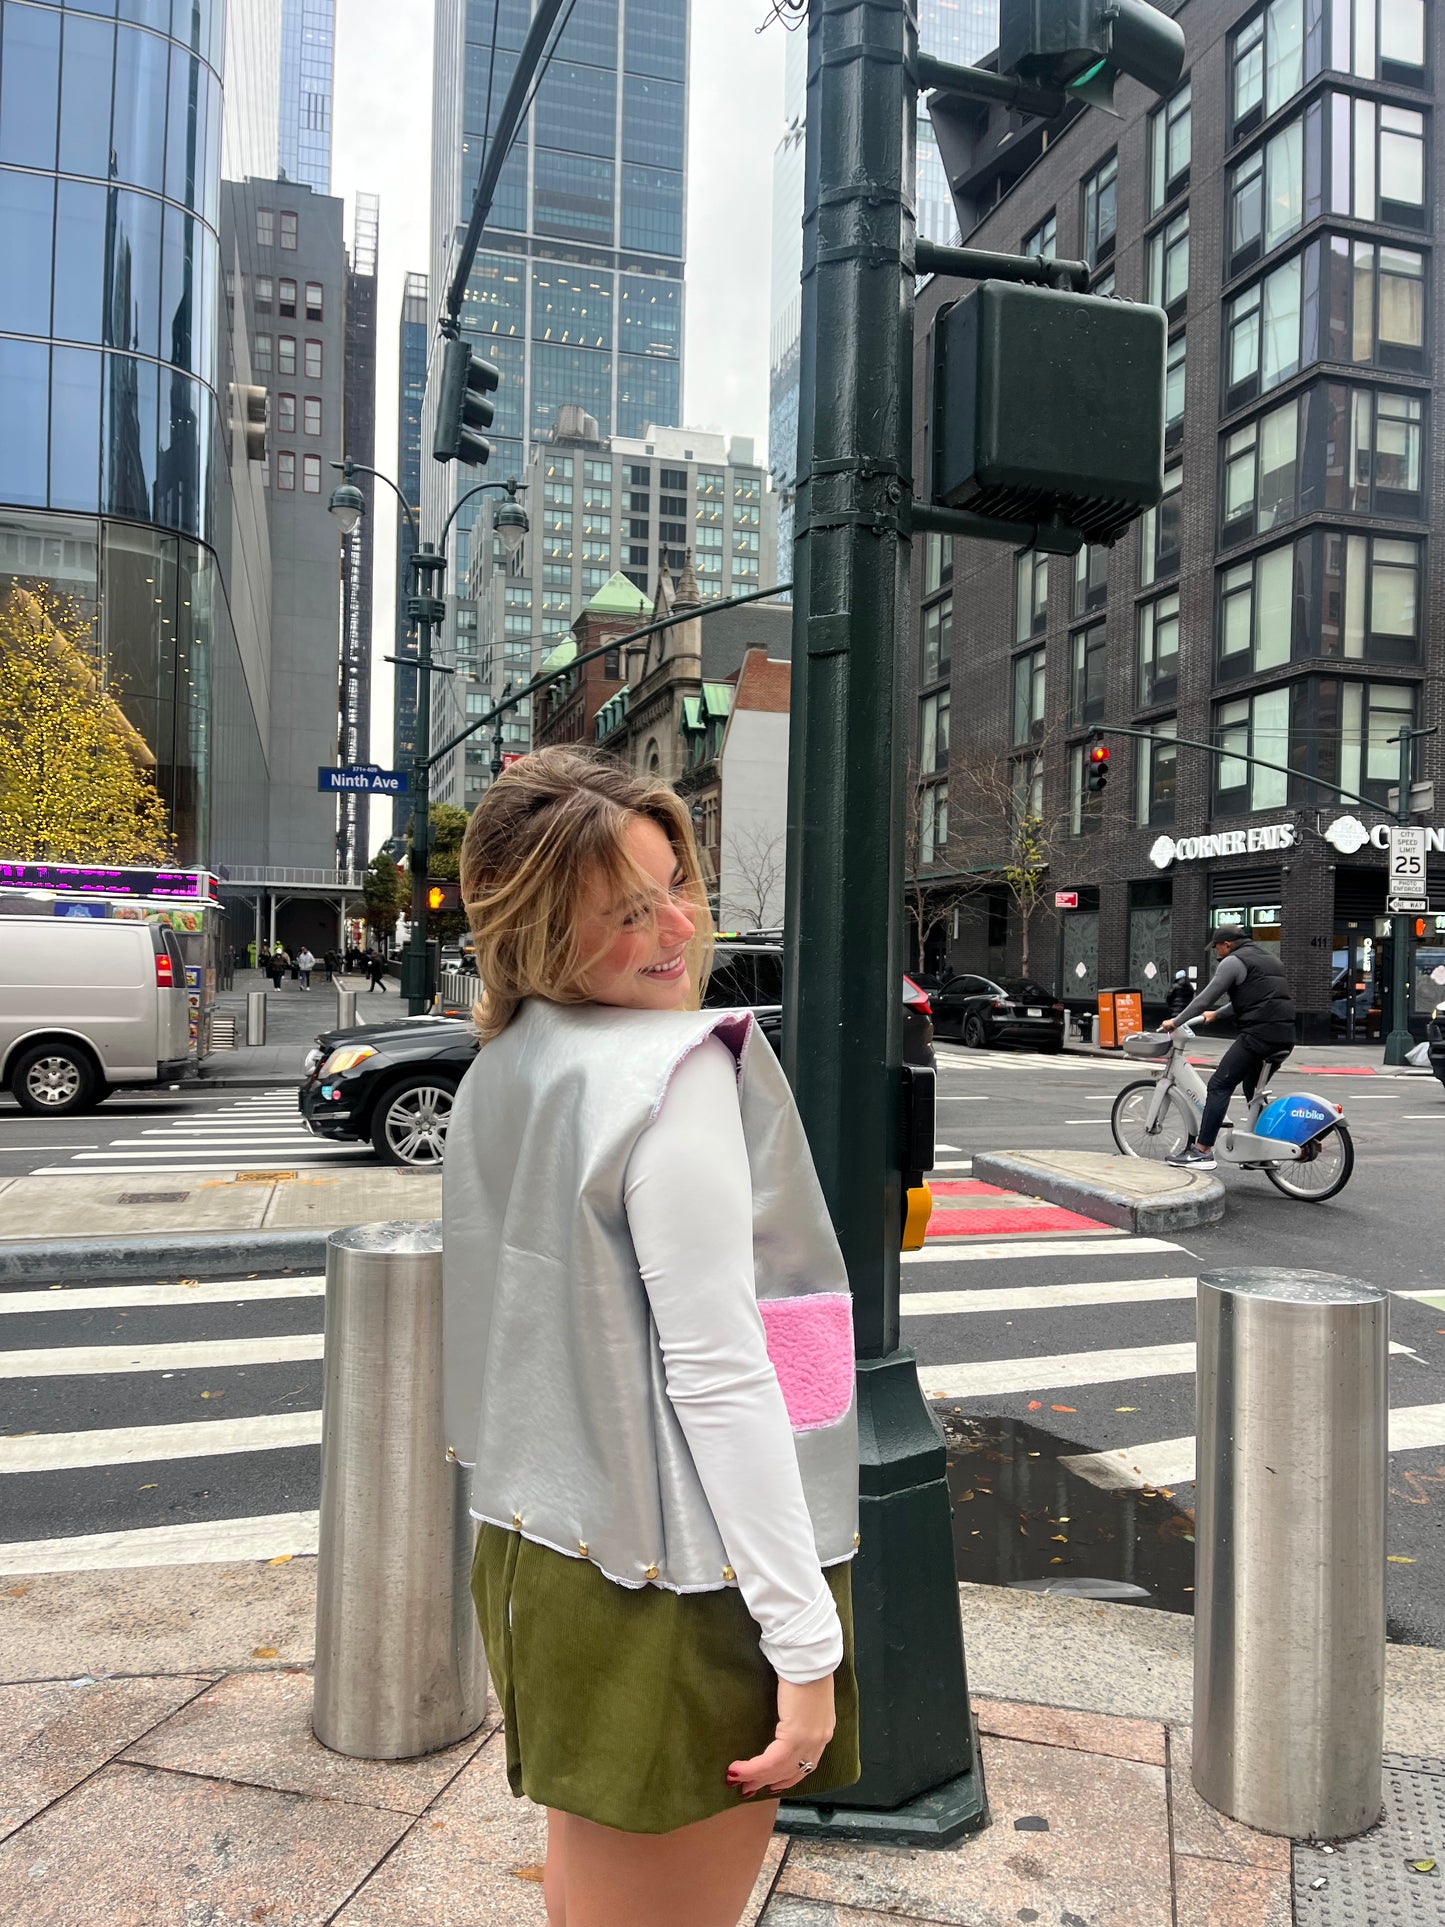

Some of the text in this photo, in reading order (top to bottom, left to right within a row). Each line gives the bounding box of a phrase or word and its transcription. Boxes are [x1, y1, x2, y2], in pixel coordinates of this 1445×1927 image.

[331, 773, 399, 789] Ninth Ave
[1176, 823, 1295, 861] CORNER EATS
[1395, 856, 1421, 874] 25
[1310, 937, 1327, 947] 411
[1362, 938, 1373, 972] OPEN
[1291, 1108, 1325, 1121] citi bike
